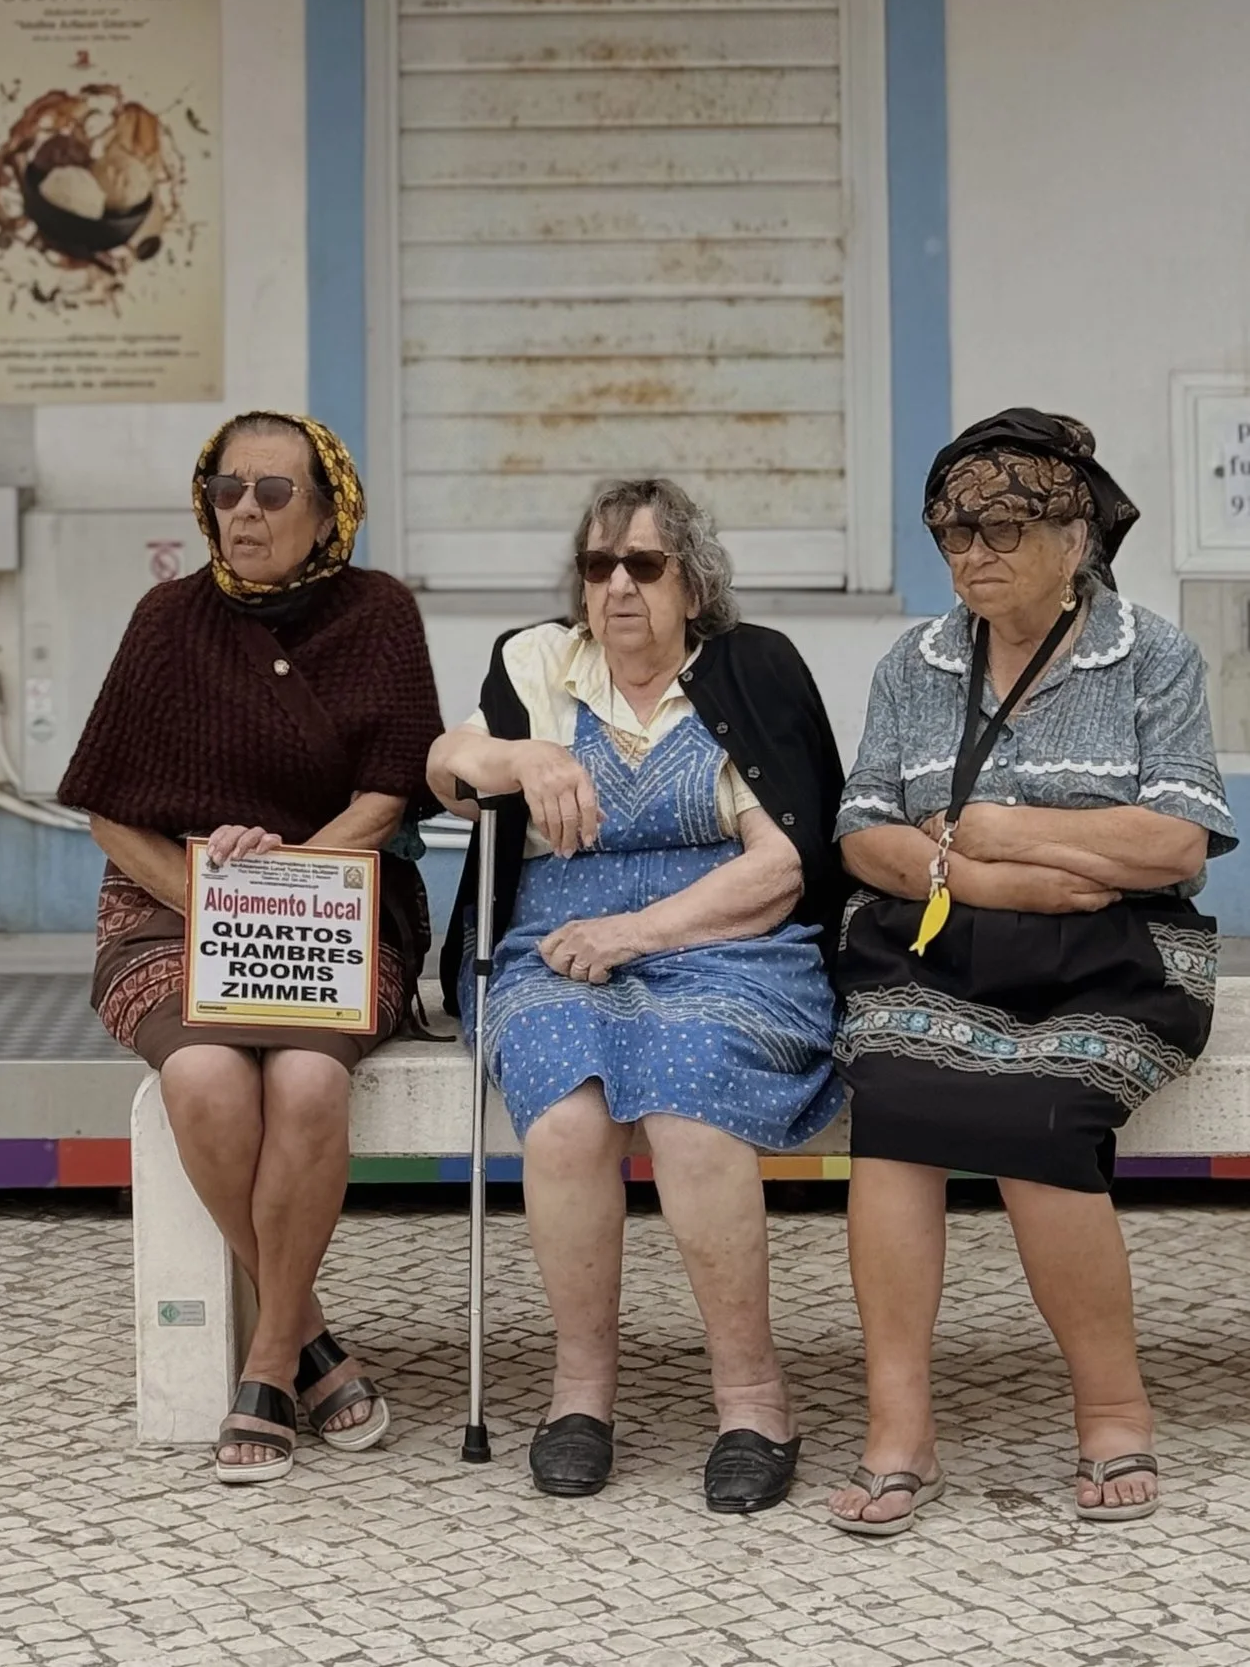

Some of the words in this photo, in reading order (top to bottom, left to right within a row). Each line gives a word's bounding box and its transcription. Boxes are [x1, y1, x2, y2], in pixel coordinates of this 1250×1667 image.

[204, 886, 306, 919] Alojamento
[313, 894, 362, 921] Local
[212, 920, 353, 944] QUARTOS
[200, 940, 364, 965] CHAMBRES
[228, 961, 334, 982] ROOMS
[220, 981, 339, 1003] ZIMMER
